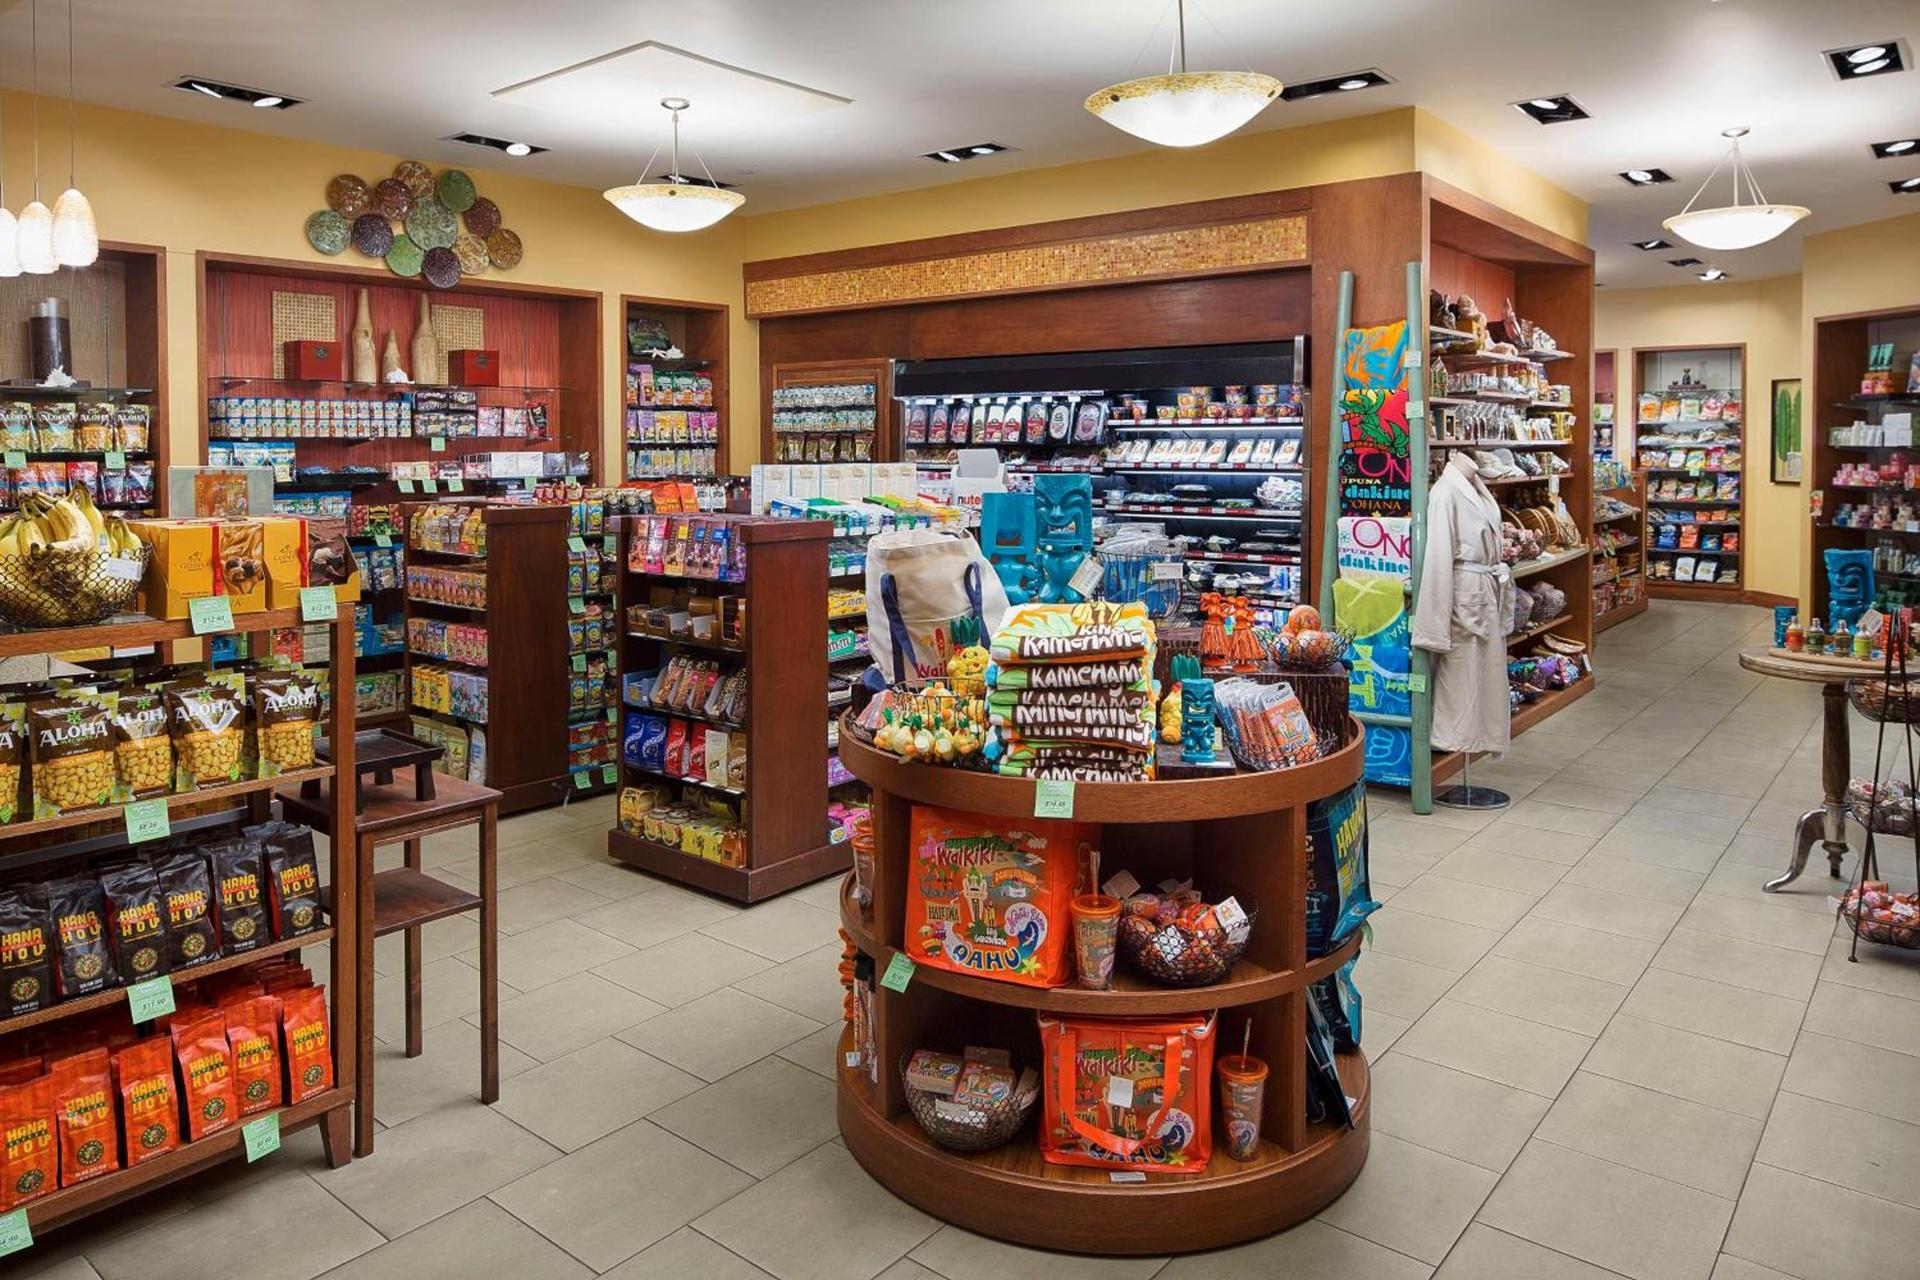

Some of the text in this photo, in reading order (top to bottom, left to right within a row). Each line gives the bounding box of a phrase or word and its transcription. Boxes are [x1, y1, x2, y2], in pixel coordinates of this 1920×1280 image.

[1340, 555, 1410, 574] dakine
[265, 690, 318, 714] ALOHA
[40, 720, 109, 748] ALOHA
[280, 864, 312, 881] HANA
[222, 874, 257, 891] HANA
[169, 890, 205, 907] HANA
[59, 911, 97, 929] HANA
[119, 902, 157, 921] HANA
[1, 927, 43, 946] HANA
[953, 944, 1020, 970] OAHU
